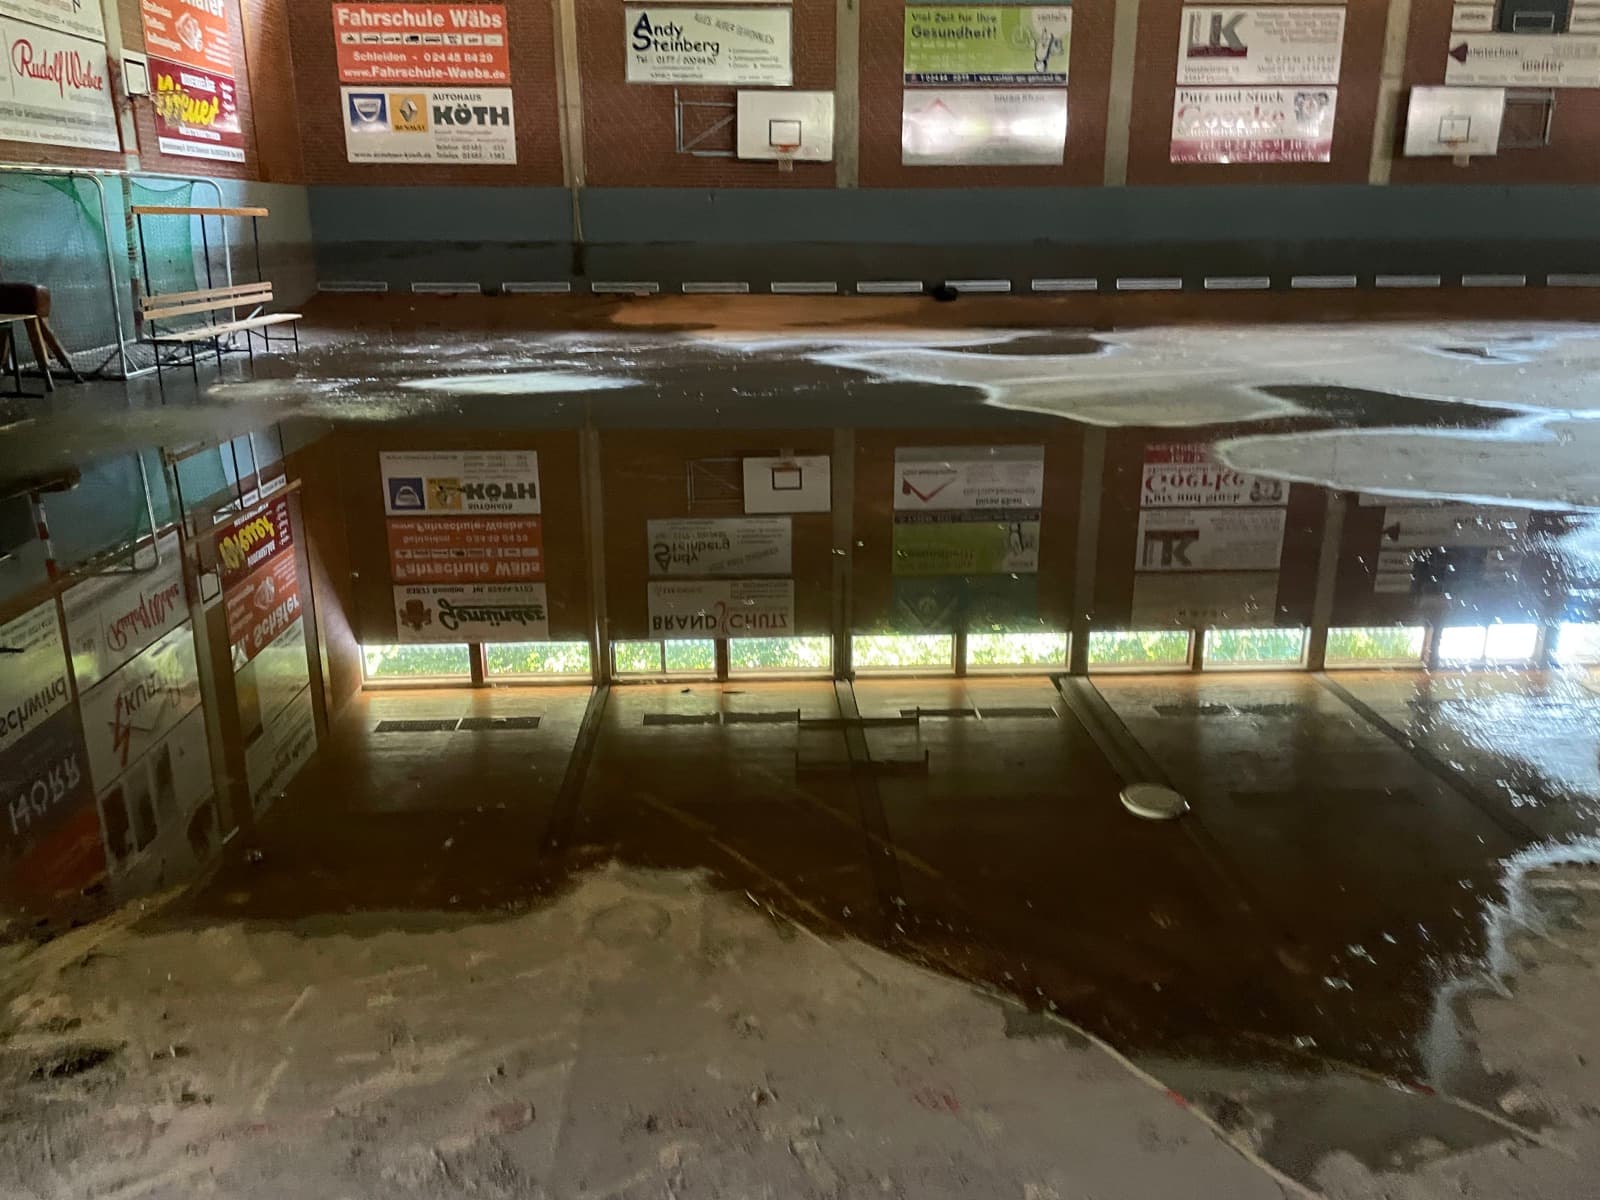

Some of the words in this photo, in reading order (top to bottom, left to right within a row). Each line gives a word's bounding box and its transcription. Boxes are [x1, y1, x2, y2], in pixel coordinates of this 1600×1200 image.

[337, 9, 445, 28] Fahrschule
[450, 9, 503, 29] Wäbs
[633, 12, 683, 38] Andy
[935, 12, 954, 23] Zeit
[911, 25, 998, 40] Gesundheit!
[632, 29, 720, 56] Steinberg
[353, 51, 407, 63] Schleiden
[11, 39, 63, 99] Rudolf
[63, 50, 104, 91] Weber
[432, 93, 482, 102] AUTOHAUS
[1215, 91, 1242, 104] und
[1247, 91, 1285, 105] Stuck
[432, 103, 510, 126] KÖTH
